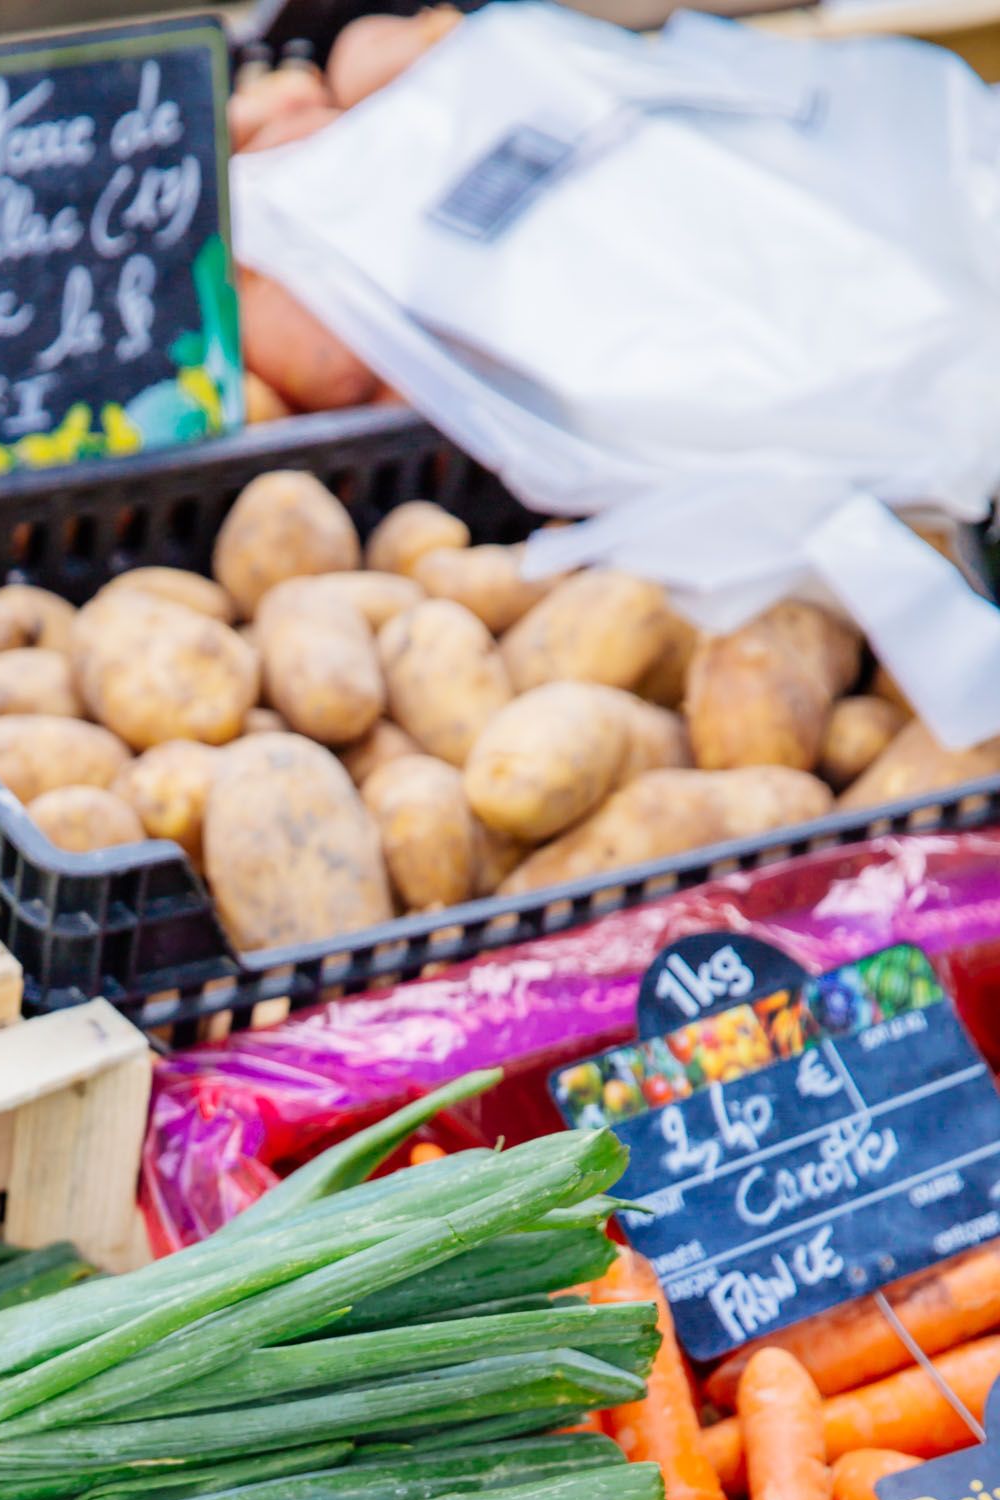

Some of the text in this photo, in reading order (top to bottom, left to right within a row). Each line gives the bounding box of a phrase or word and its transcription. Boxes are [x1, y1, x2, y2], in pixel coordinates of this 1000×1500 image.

[109, 60, 185, 160] de
[654, 944, 755, 1018] 1kg
[795, 1048, 845, 1098] €
